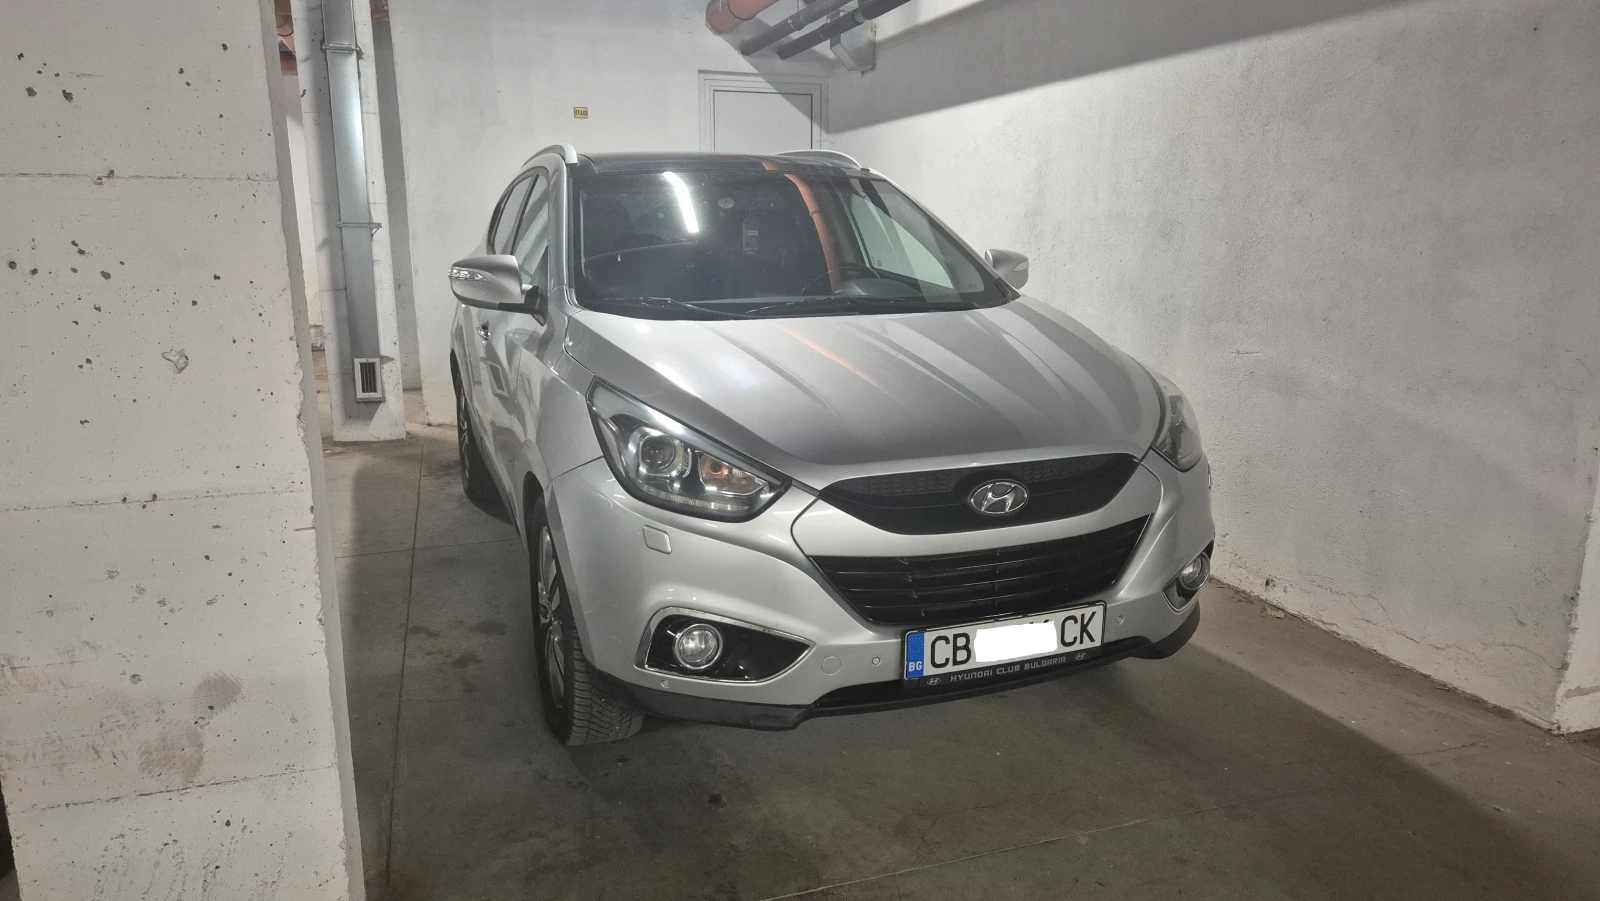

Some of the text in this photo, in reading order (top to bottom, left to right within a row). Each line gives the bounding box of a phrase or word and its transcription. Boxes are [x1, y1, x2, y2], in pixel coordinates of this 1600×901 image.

[930, 611, 1097, 669] CB CK
[908, 661, 923, 672] BG
[950, 656, 1066, 683] HYUNDAI CLUB BULGARIA
